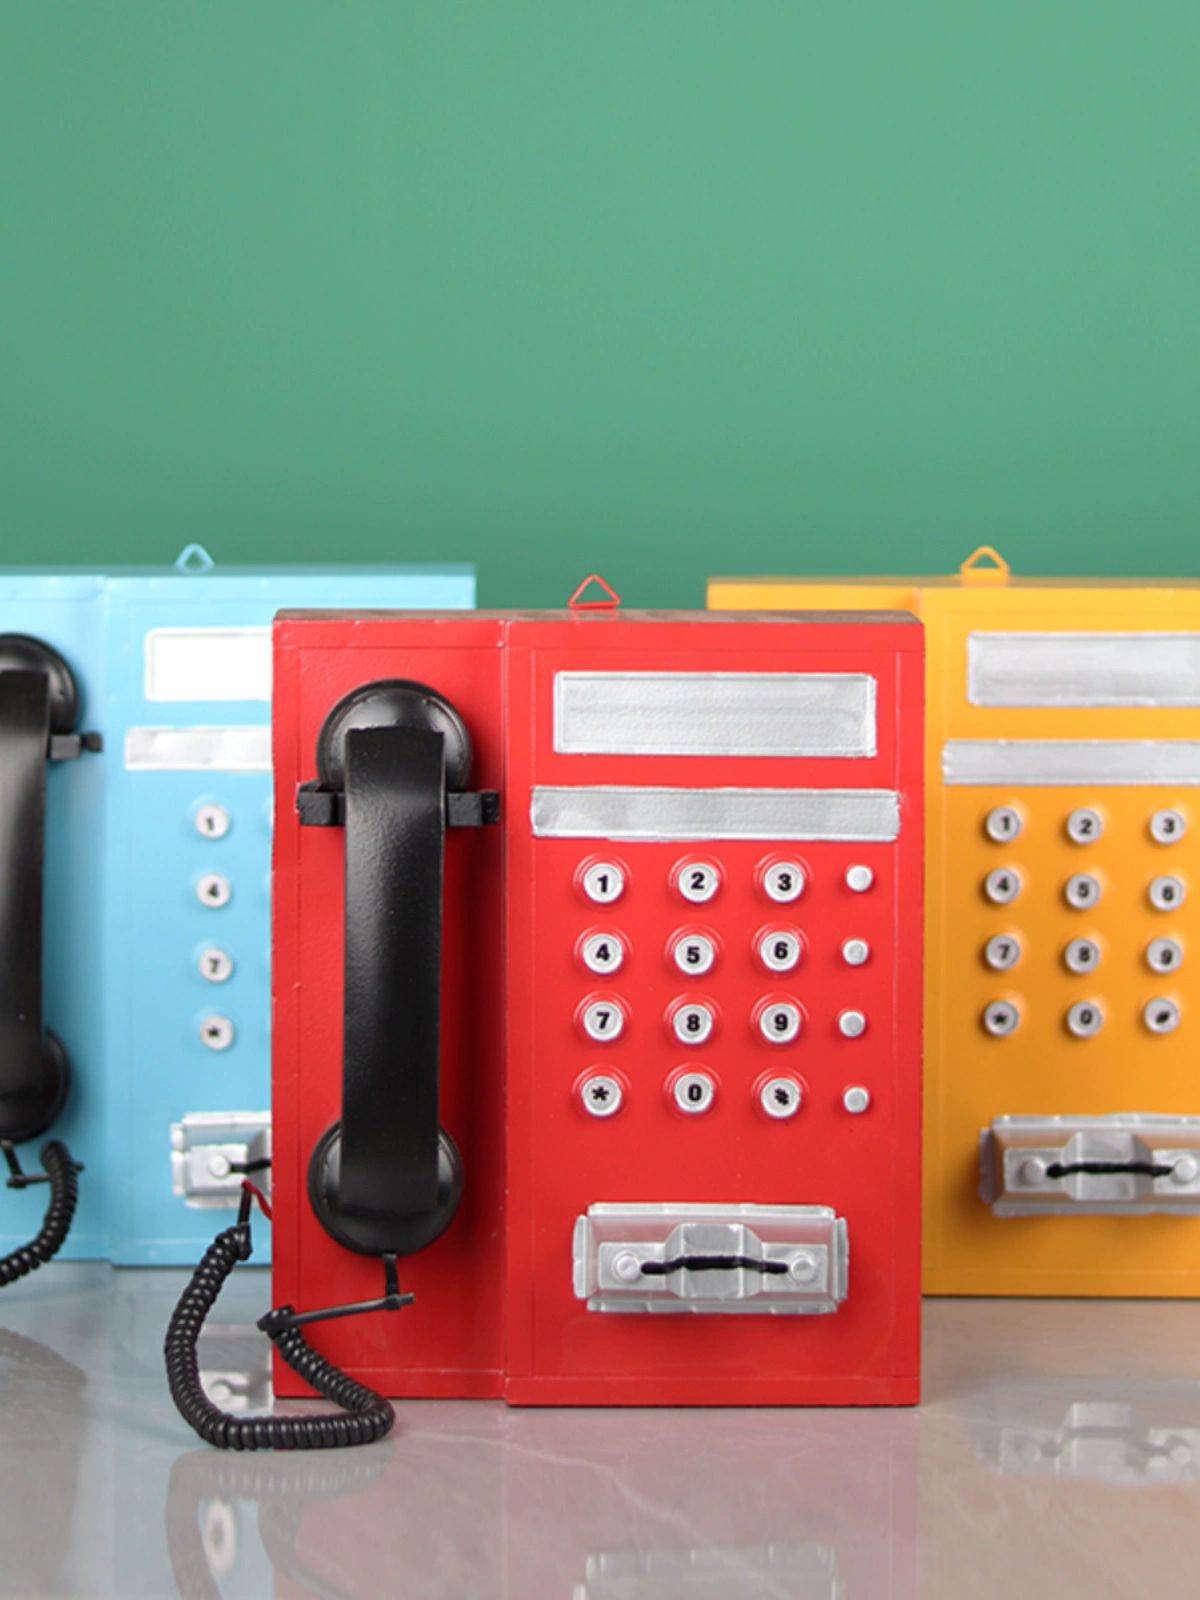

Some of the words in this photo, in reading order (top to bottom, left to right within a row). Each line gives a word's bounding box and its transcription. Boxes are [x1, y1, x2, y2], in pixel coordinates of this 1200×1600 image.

[1001, 816, 1010, 831] 1
[1080, 819, 1092, 835] 2
[1164, 819, 1175, 834] 3
[596, 875, 609, 893] 1
[691, 872, 705, 890] 2
[778, 873, 792, 892] 3
[997, 877, 1009, 892] 4
[1078, 882, 1090, 899] 5
[1162, 886, 1174, 902] 6
[595, 943, 610, 962] 4
[686, 946, 700, 965] 5
[774, 941, 789, 960] 6
[999, 944, 1010, 960] 7
[1079, 947, 1090, 963] 8
[1161, 949, 1173, 965] 9
[596, 1011, 610, 1030] 7
[686, 1014, 701, 1032] 8
[774, 1013, 789, 1032] 9
[1080, 1009, 1093, 1025] 0
[688, 1084, 702, 1102] 0
